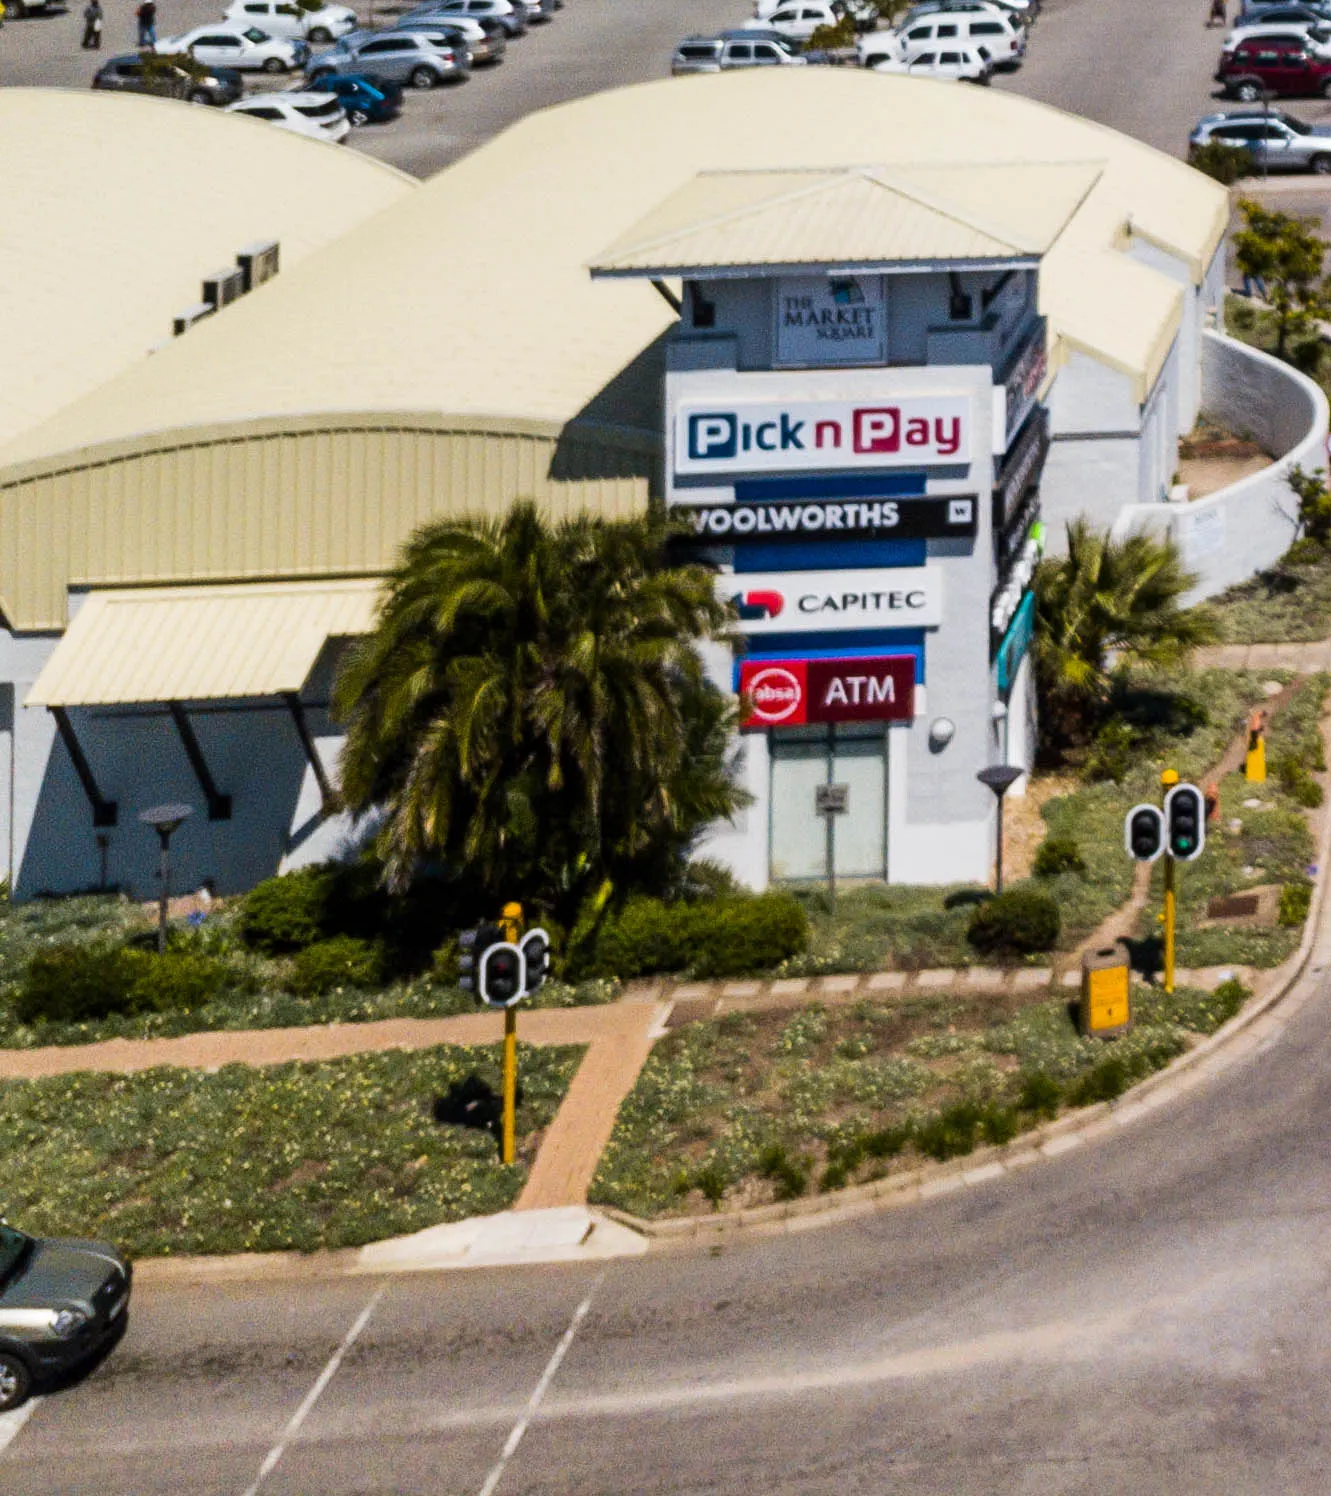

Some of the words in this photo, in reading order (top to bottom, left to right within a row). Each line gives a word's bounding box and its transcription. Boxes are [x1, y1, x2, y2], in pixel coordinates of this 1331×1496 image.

[786, 295, 812, 310] THE
[784, 307, 875, 326] MARKET
[816, 327, 875, 342] SQUARE
[688, 412, 806, 460] Pick
[815, 420, 842, 450] n
[852, 407, 962, 455] Pay
[798, 591, 926, 613] CAPITEC
[754, 683, 796, 702] absa
[824, 675, 896, 707] ATM
